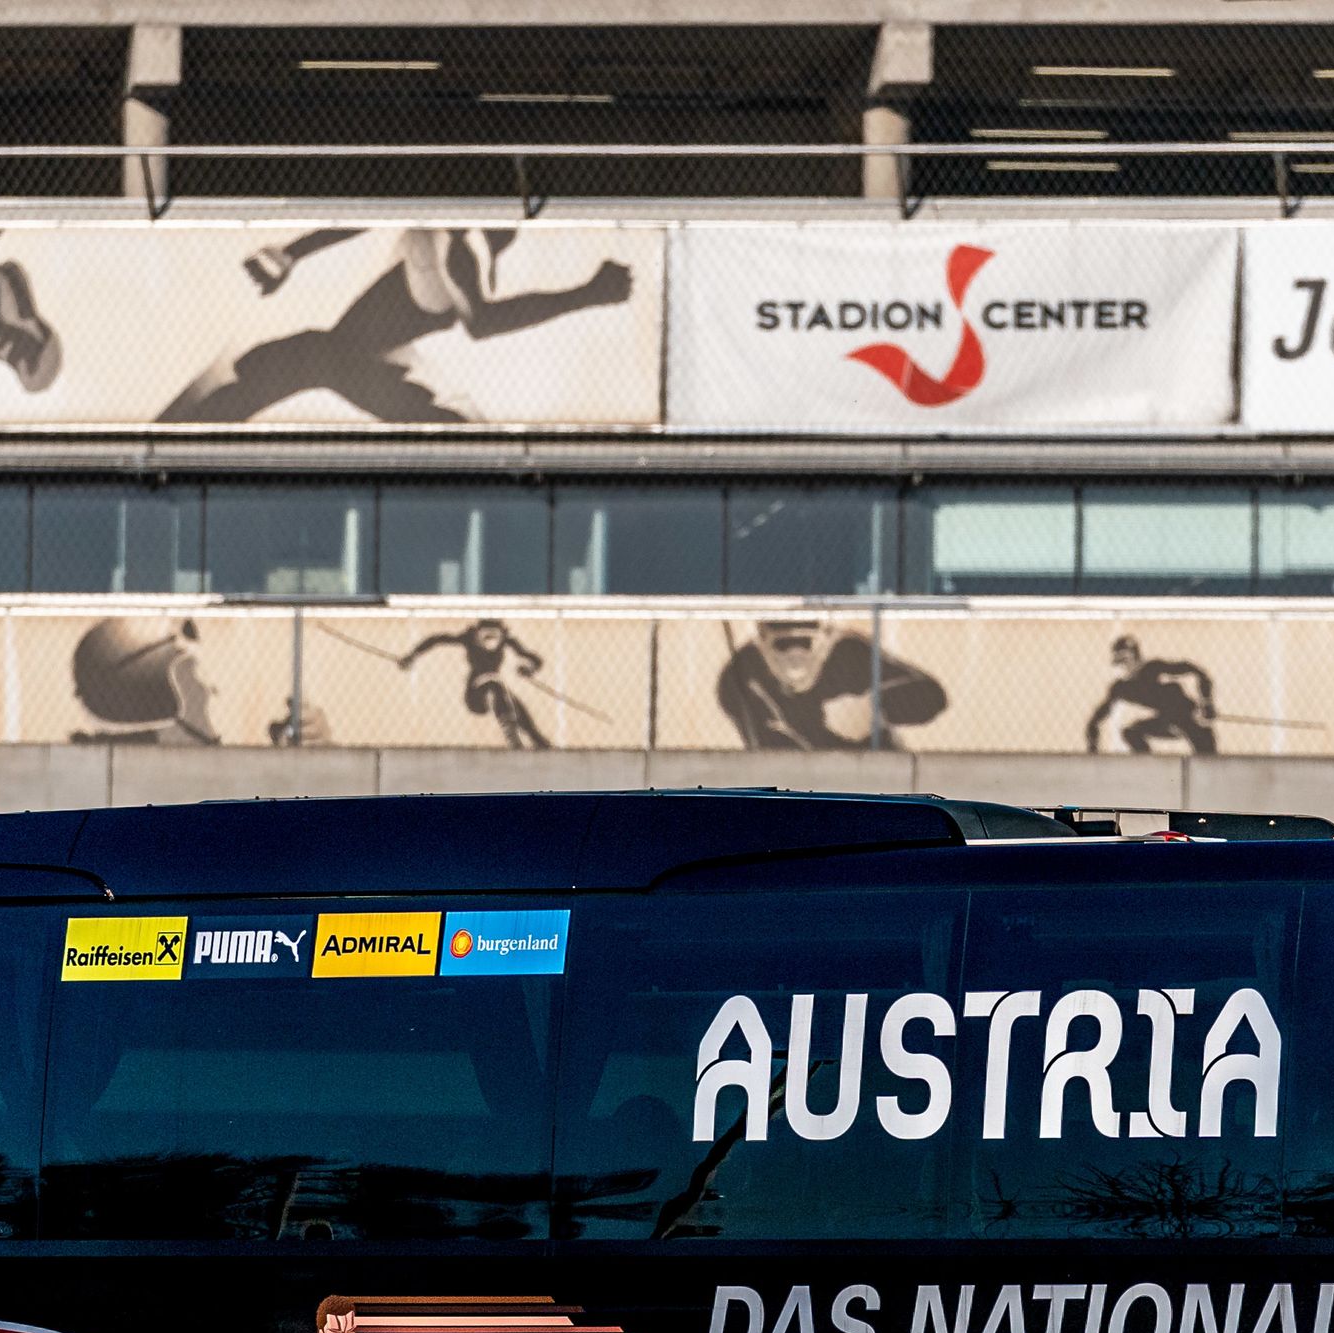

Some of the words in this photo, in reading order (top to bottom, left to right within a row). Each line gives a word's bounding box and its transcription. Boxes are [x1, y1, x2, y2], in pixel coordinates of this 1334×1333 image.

[756, 300, 943, 331] STADION
[981, 298, 1148, 331] CENTER
[65, 945, 154, 967] Raiffeisen
[321, 932, 431, 957] ADMIRAL
[476, 933, 559, 955] burgenland
[692, 987, 1283, 1142] AUSTRIA
